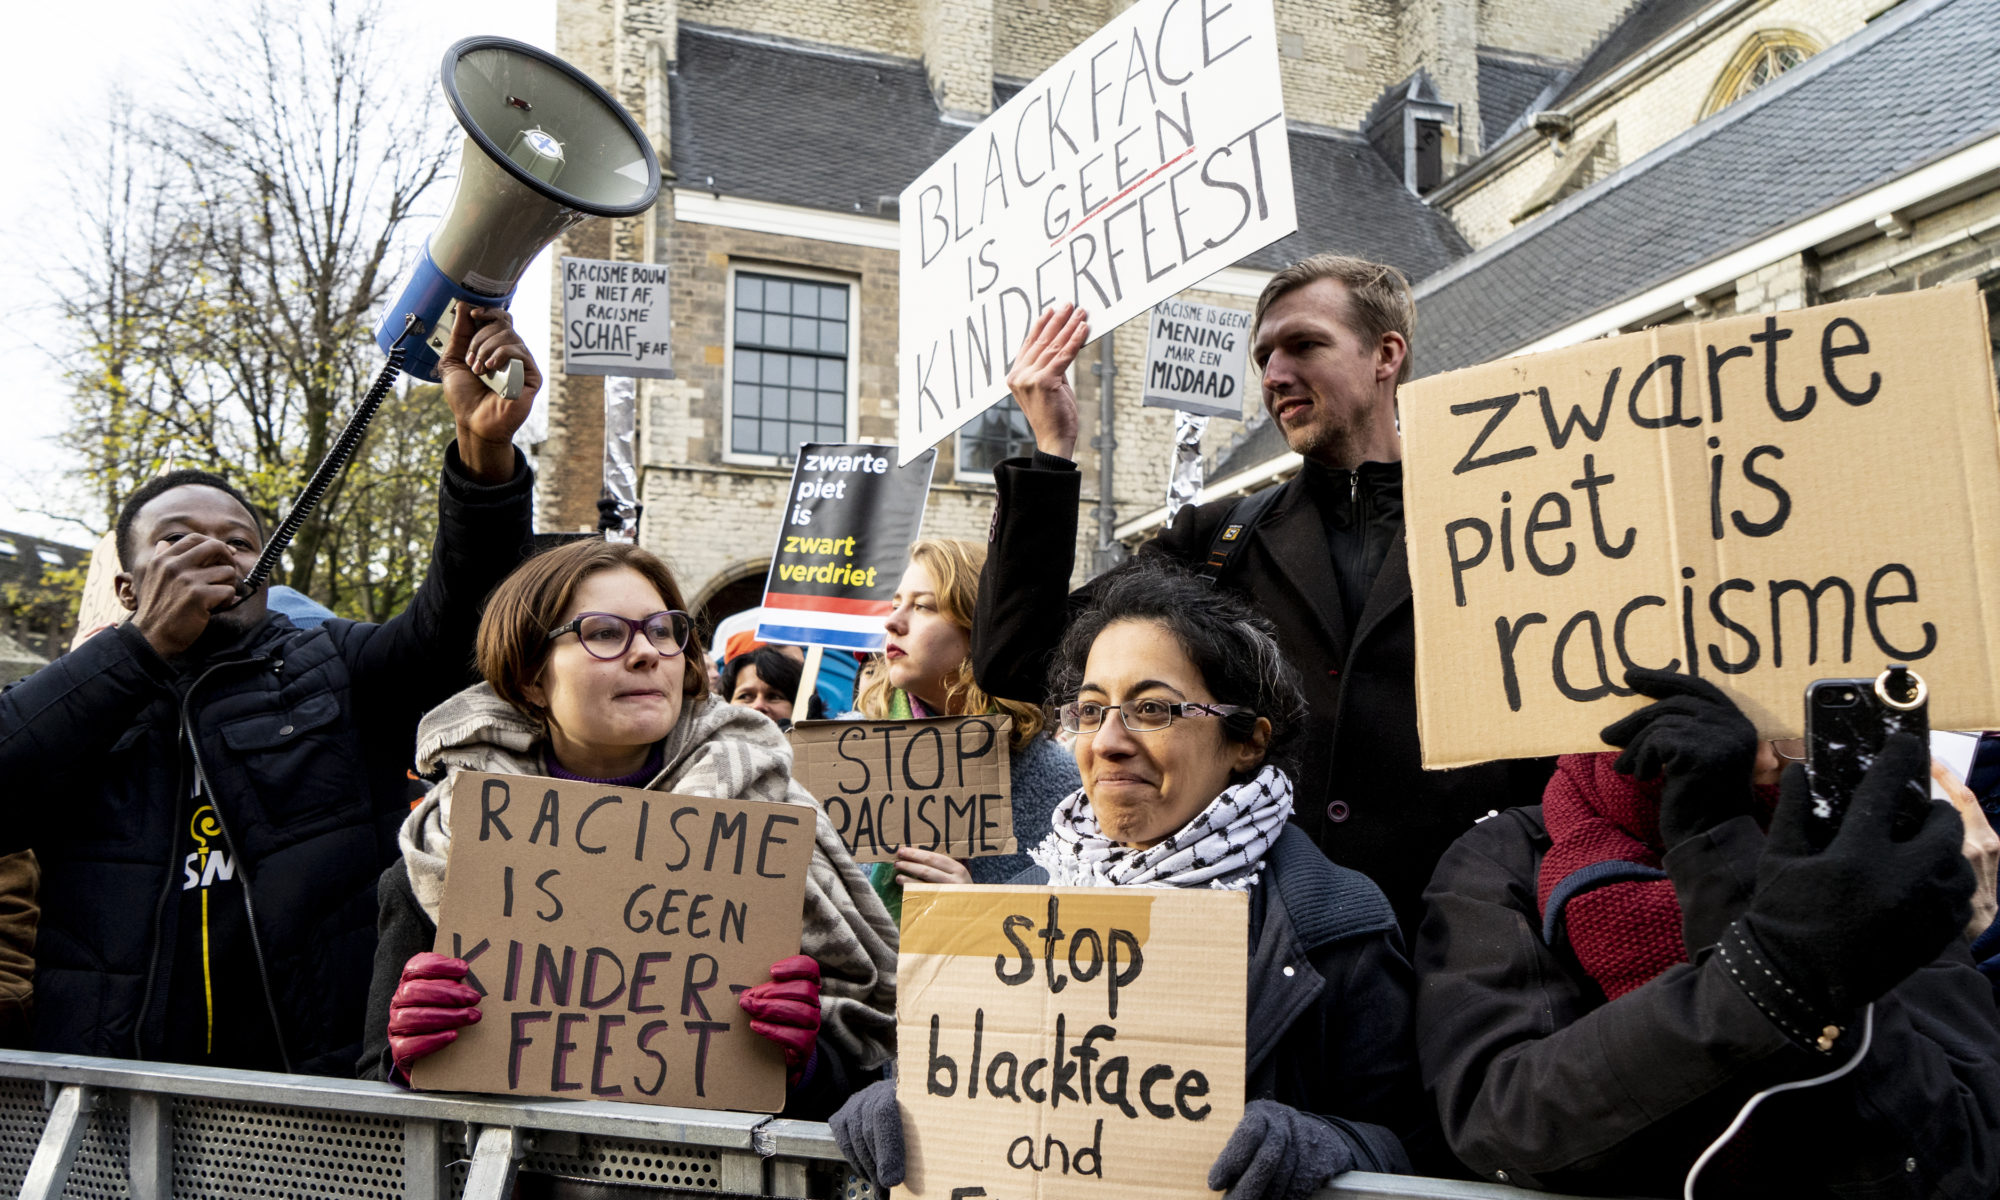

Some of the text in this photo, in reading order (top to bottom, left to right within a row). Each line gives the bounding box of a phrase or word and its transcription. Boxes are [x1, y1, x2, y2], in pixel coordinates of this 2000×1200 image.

[918, 0, 1252, 269] BLACKFACE
[967, 91, 1195, 302] IS GEEN
[567, 262, 666, 285] RACISME BOUW
[568, 283, 654, 307] JE NIET AF,
[916, 112, 1282, 433] KINDERFEEST
[569, 320, 668, 361] SCHAF JE AF
[586, 303, 650, 323] RACISME
[1154, 301, 1248, 329] RACISME IS GEEN
[1156, 317, 1236, 353] MENING
[1150, 360, 1236, 399] MISDAAD
[1164, 344, 1222, 368] MAAR EEN
[1450, 316, 1882, 475] zwarte
[796, 477, 847, 502] piet
[803, 453, 889, 475] zwarte
[783, 535, 856, 557] zwart
[791, 503, 812, 526] is
[1445, 435, 1792, 608] piet is
[778, 561, 878, 588] verdriet
[1494, 563, 1938, 712] racisme
[837, 719, 996, 795] STOP
[478, 779, 800, 879] RACISME
[824, 793, 1004, 857] RACISME
[503, 866, 748, 945] IS GEEN
[453, 932, 754, 1022] KINDER-
[994, 894, 1144, 1020] stop
[508, 1010, 731, 1098] FEEST
[926, 1007, 1213, 1122] blackface
[1006, 1118, 1104, 1180] and
